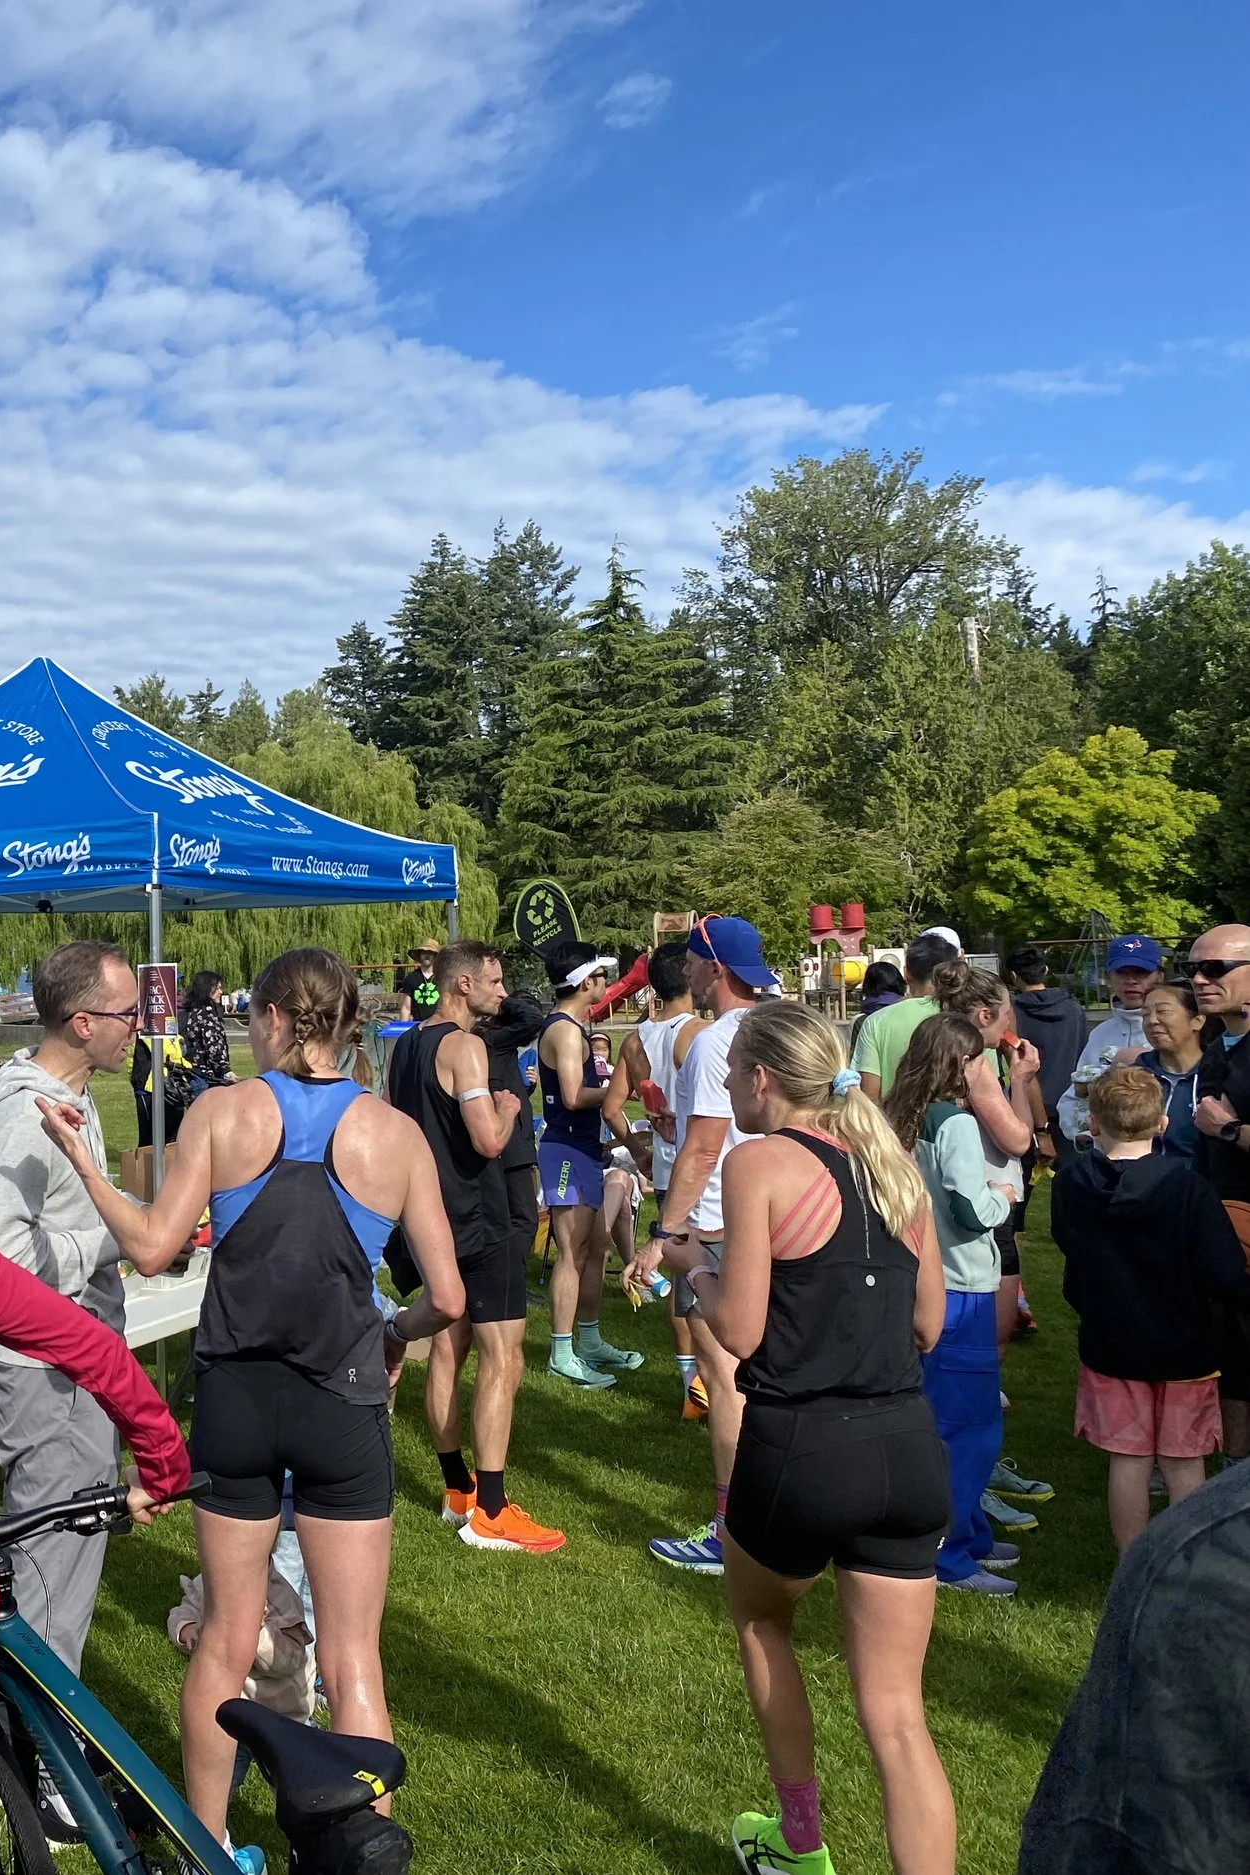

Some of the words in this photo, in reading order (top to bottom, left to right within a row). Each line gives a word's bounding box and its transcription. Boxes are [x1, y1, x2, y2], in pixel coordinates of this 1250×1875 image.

[2, 720, 45, 746] STORE
[125, 759, 275, 816] Stong's
[2, 831, 91, 878] Stong's
[169, 833, 221, 875] Stong's
[271, 855, 370, 880] www.Stongs.com
[532, 924, 563, 947] RECYCLE
[533, 917, 558, 938] PLEASE
[557, 1160, 571, 1200] ADIZERO
